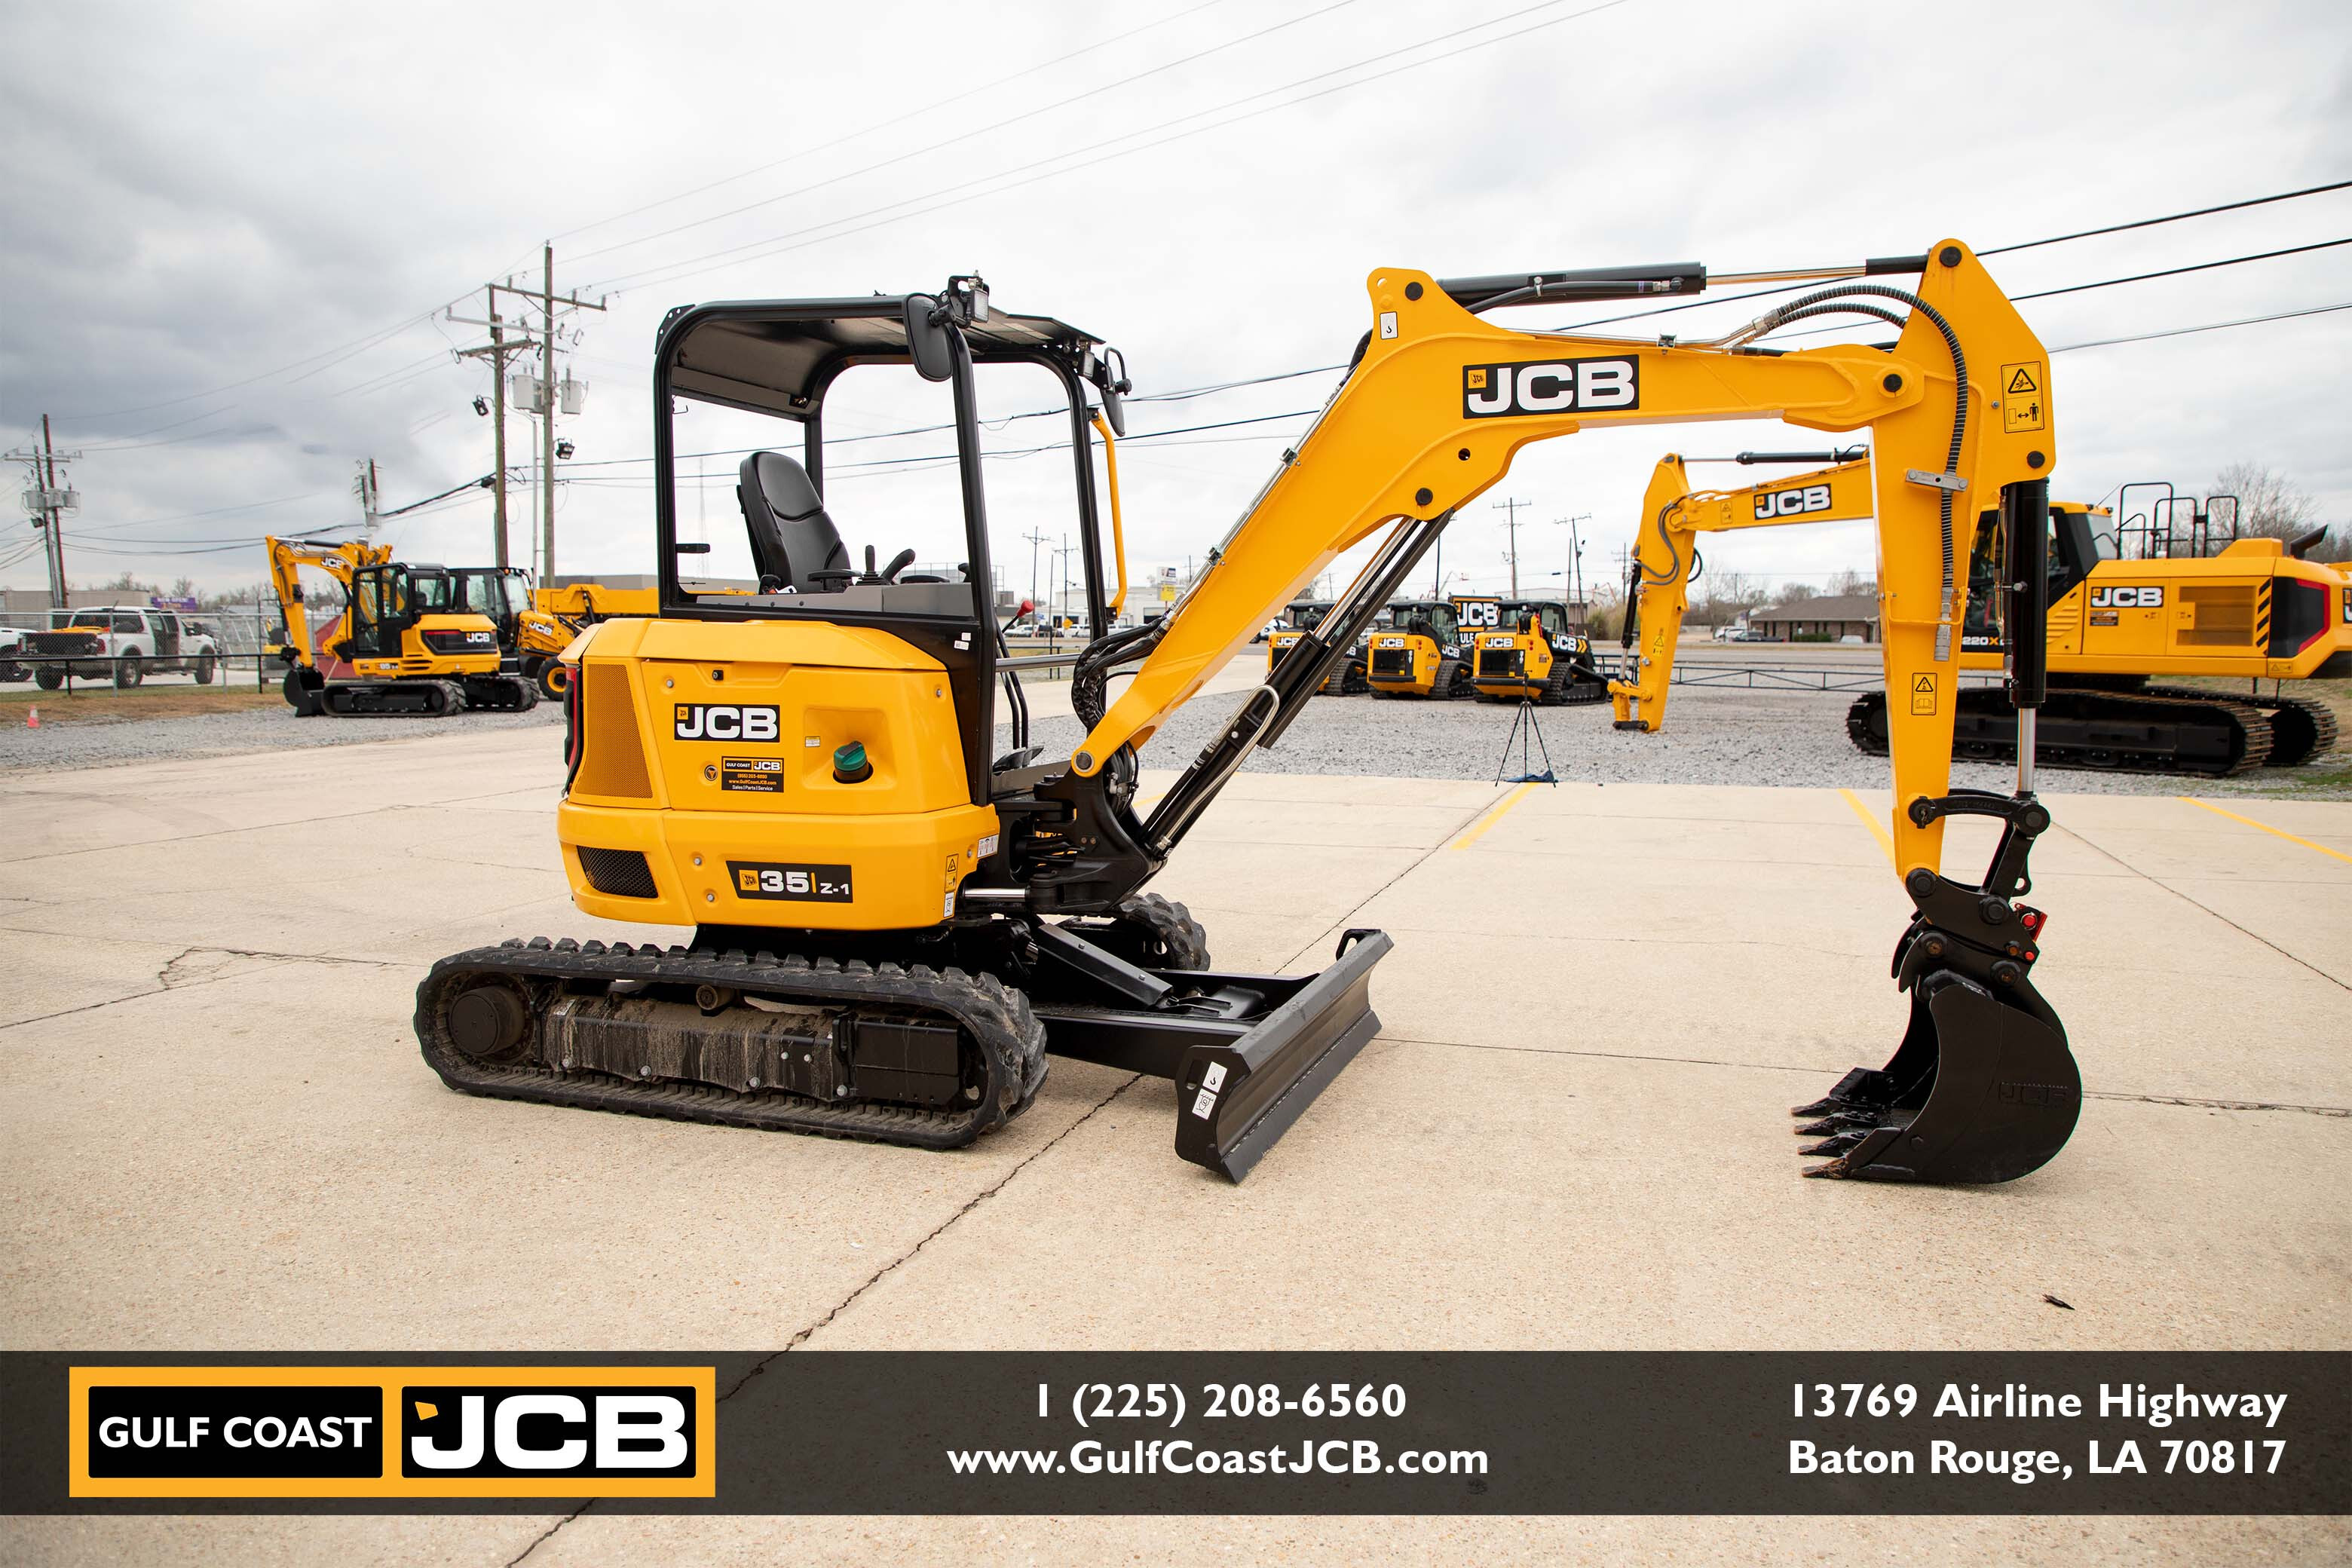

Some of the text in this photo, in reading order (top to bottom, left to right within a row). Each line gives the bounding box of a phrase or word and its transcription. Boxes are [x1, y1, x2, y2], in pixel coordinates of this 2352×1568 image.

[1468, 360, 1635, 414] JCB
[1755, 485, 1831, 519] JCB
[2091, 587, 2163, 607] JCB
[1457, 602, 1499, 626] JCB
[529, 621, 553, 635] JCB
[467, 632, 491, 642] JCB
[1378, 639, 1405, 648] JCB
[1485, 638, 1514, 648] JCB
[1551, 634, 1577, 651] JCB
[1442, 645, 1460, 658] JCB
[677, 706, 778, 740] JCB
[754, 761, 780, 770] JCB
[761, 870, 850, 895] 35 Z-1
